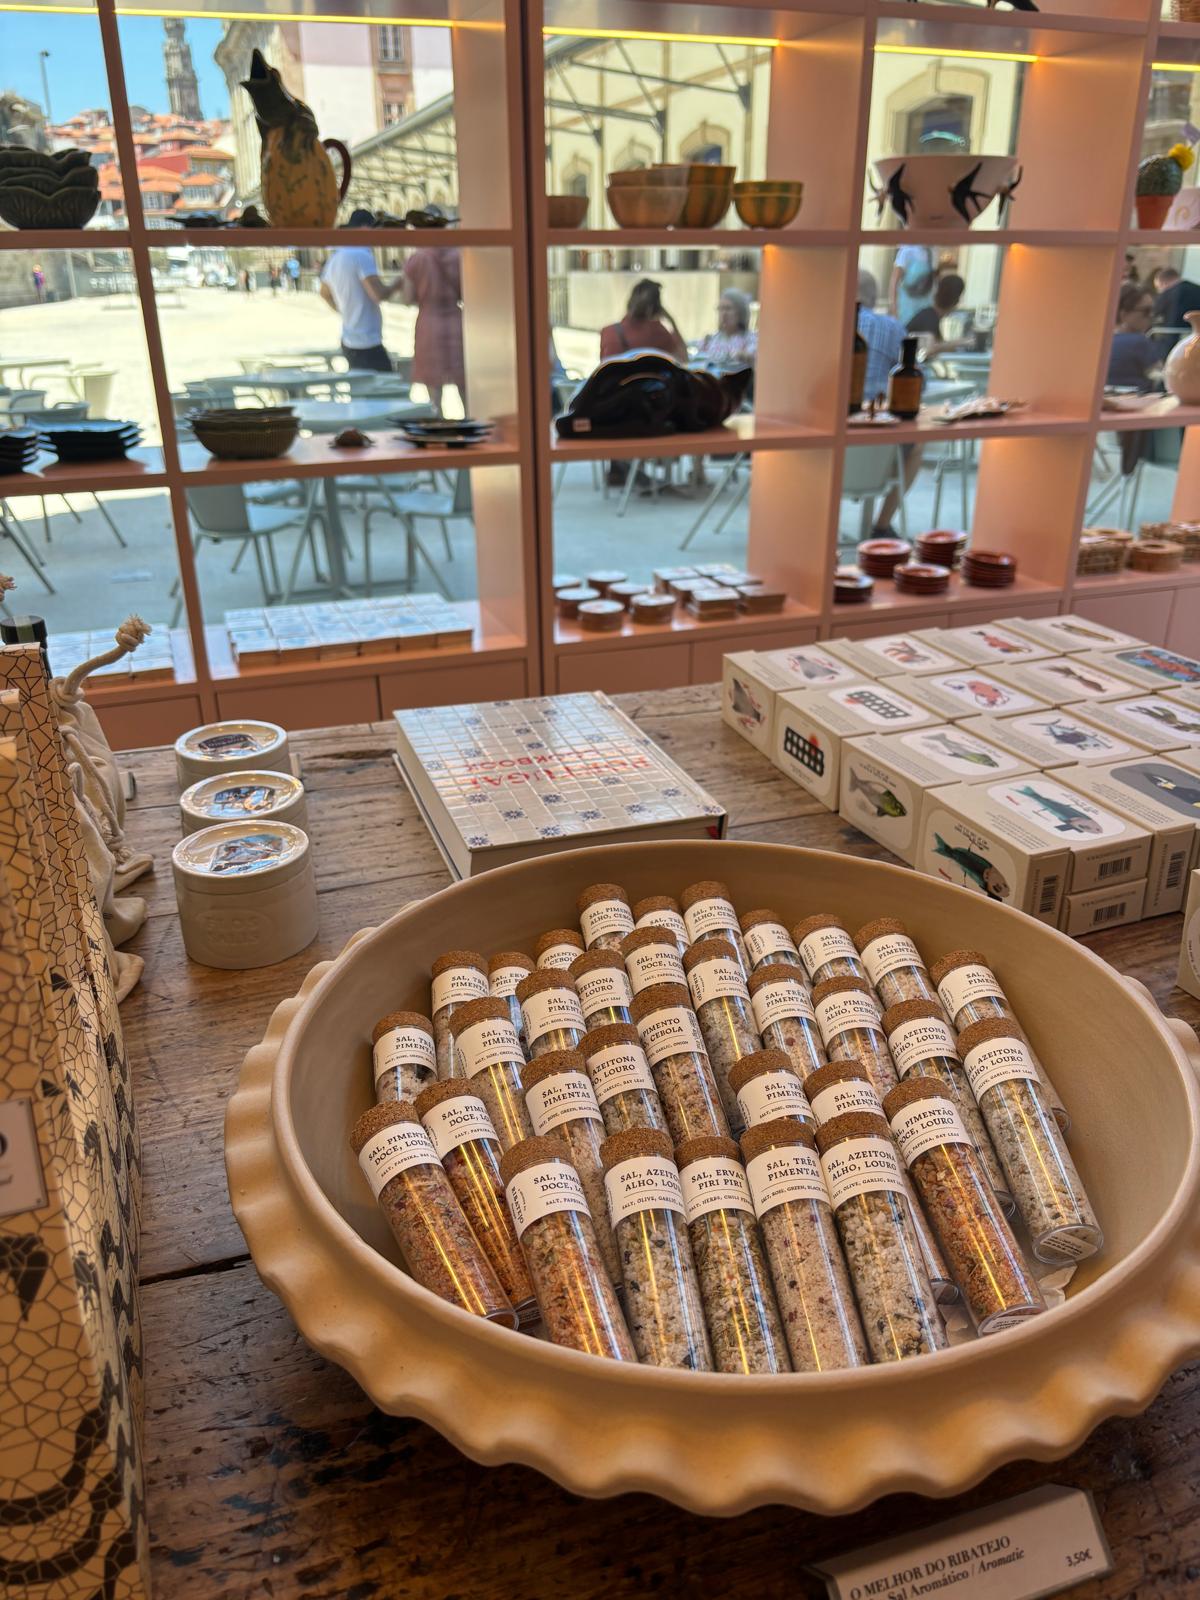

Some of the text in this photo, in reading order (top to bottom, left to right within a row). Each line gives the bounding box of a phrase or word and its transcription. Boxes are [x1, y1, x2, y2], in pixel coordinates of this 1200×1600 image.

[978, 1048, 1023, 1063] AZEITONA
[991, 1056, 1023, 1066] LOURO
[591, 1056, 636, 1076] AZEITONA
[604, 1064, 636, 1078] LOURO
[541, 1081, 587, 1098] SAL, TRÊS
[543, 1091, 591, 1108] PIMENTAS
[441, 1108, 462, 1121] SAL,
[449, 1113, 478, 1126] DOCE,
[905, 1108, 954, 1127] PIMENTÃO
[920, 1118, 954, 1129] LOURO
[368, 1145, 385, 1161] SAL,
[374, 1146, 402, 1166] DOCE,
[767, 1157, 817, 1170] SAL, TRÊS
[828, 1151, 896, 1173] SAL, AZEITONA
[620, 1171, 642, 1182] SAL,
[691, 1169, 744, 1183] SAL, ERVAS
[768, 1168, 820, 1181] PIMENTAS
[832, 1160, 897, 1181] ALHO, LOURO
[533, 1174, 556, 1185] SAL,
[625, 1179, 658, 1191] ALHO,
[698, 1178, 742, 1190] PIRI PIRI
[541, 1182, 572, 1192] DOCE,
[1066, 1548, 1092, 1567] 3,50€
[850, 1536, 1010, 1600] O MELHOR DO RIBATEJO
[911, 1568, 969, 1596] Aromático
[978, 1548, 1025, 1573] Aromatic
